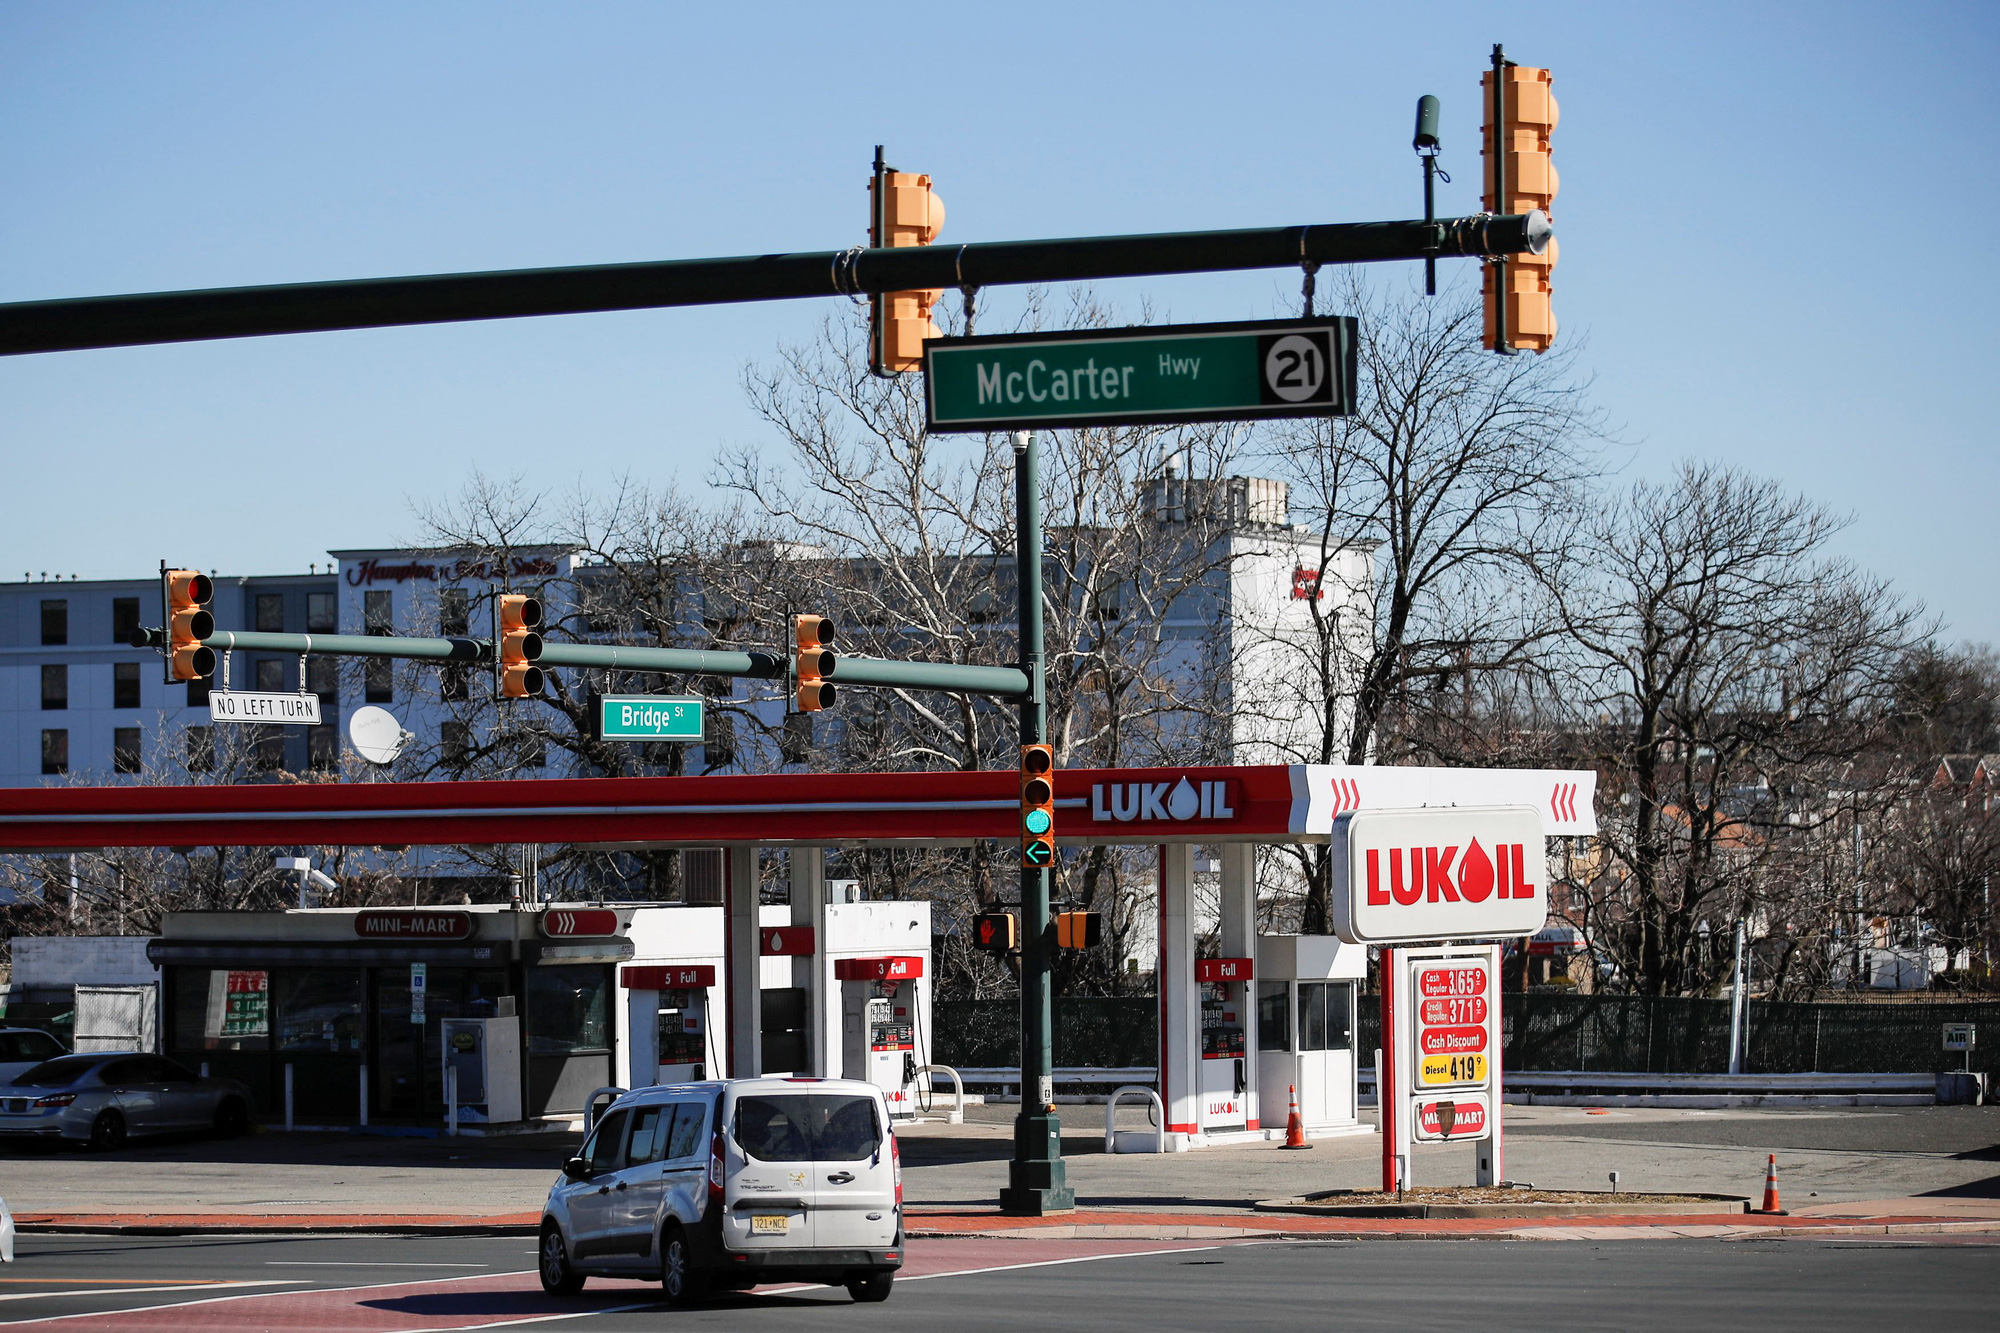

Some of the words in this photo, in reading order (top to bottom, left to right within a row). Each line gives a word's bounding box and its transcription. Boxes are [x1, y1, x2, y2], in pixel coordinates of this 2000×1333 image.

[977, 357, 1134, 405] McCarter
[1159, 353, 1200, 380] Hwy
[1275, 349, 1316, 388] 21
[347, 559, 441, 586] Hampton
[217, 698, 235, 715] NO
[243, 699, 273, 716] LEFT
[279, 700, 313, 717] TURN
[622, 705, 670, 734] Bridge
[674, 705, 684, 717] St
[1092, 775, 1234, 821] LUKOIL
[1366, 836, 1535, 906] LUKOIL
[878, 963, 884, 975] 3
[890, 961, 906, 974] Full
[1204, 965, 1209, 977] 1
[1220, 963, 1236, 976] Full
[664, 973, 671, 985] 5
[680, 970, 697, 984] Full
[1425, 972, 1440, 983] Cash
[1425, 983, 1448, 996] Regular
[1426, 1001, 1443, 1012] Credit
[1426, 1011, 1448, 1024] Regular
[1427, 1033, 1445, 1049] Cash
[1446, 1033, 1480, 1048] Discount
[1947, 1032, 1967, 1043] AIR
[1425, 1063, 1447, 1075] Diesel
[1209, 1101, 1239, 1115] LUKOIL
